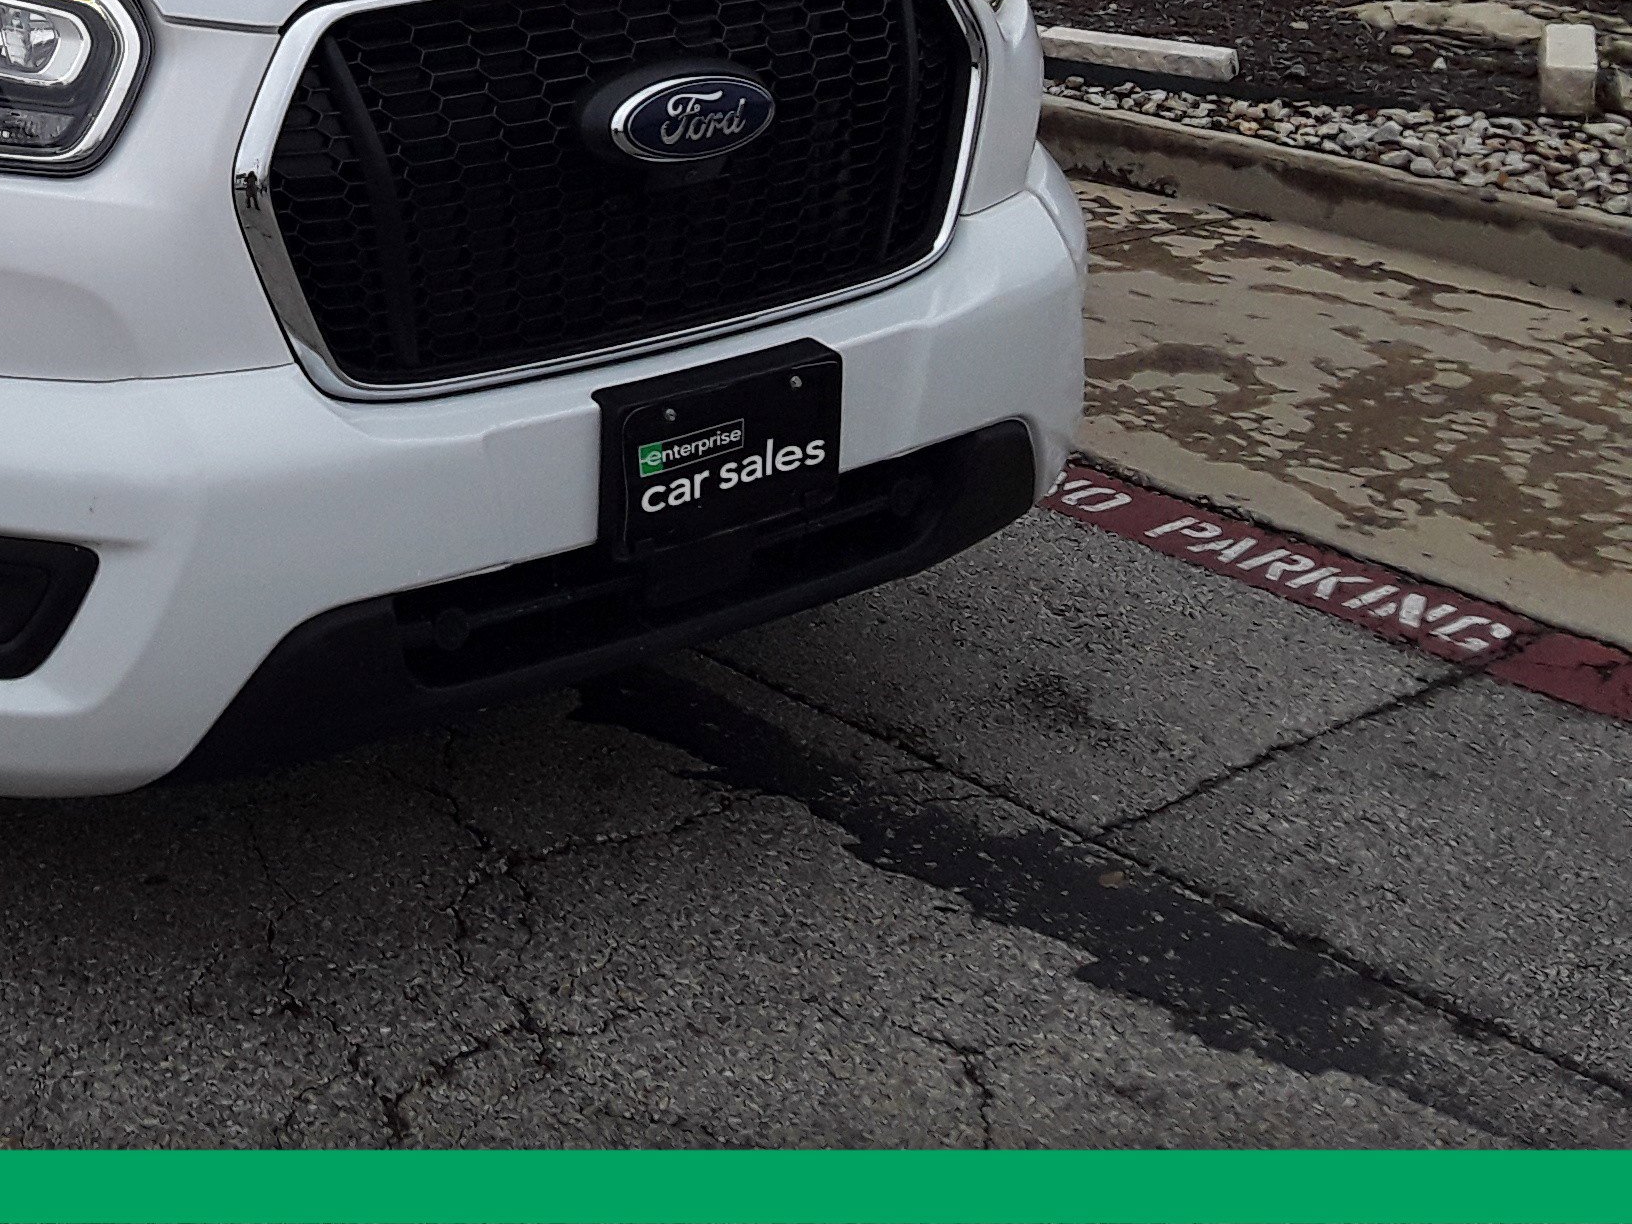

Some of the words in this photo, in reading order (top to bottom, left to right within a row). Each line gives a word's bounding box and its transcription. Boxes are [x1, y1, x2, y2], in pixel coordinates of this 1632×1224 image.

[661, 90, 747, 144] Ford
[641, 470, 710, 513] car
[719, 438, 826, 489] sales
[645, 429, 742, 466] enterprise
[1144, 516, 1512, 651] PARKING
